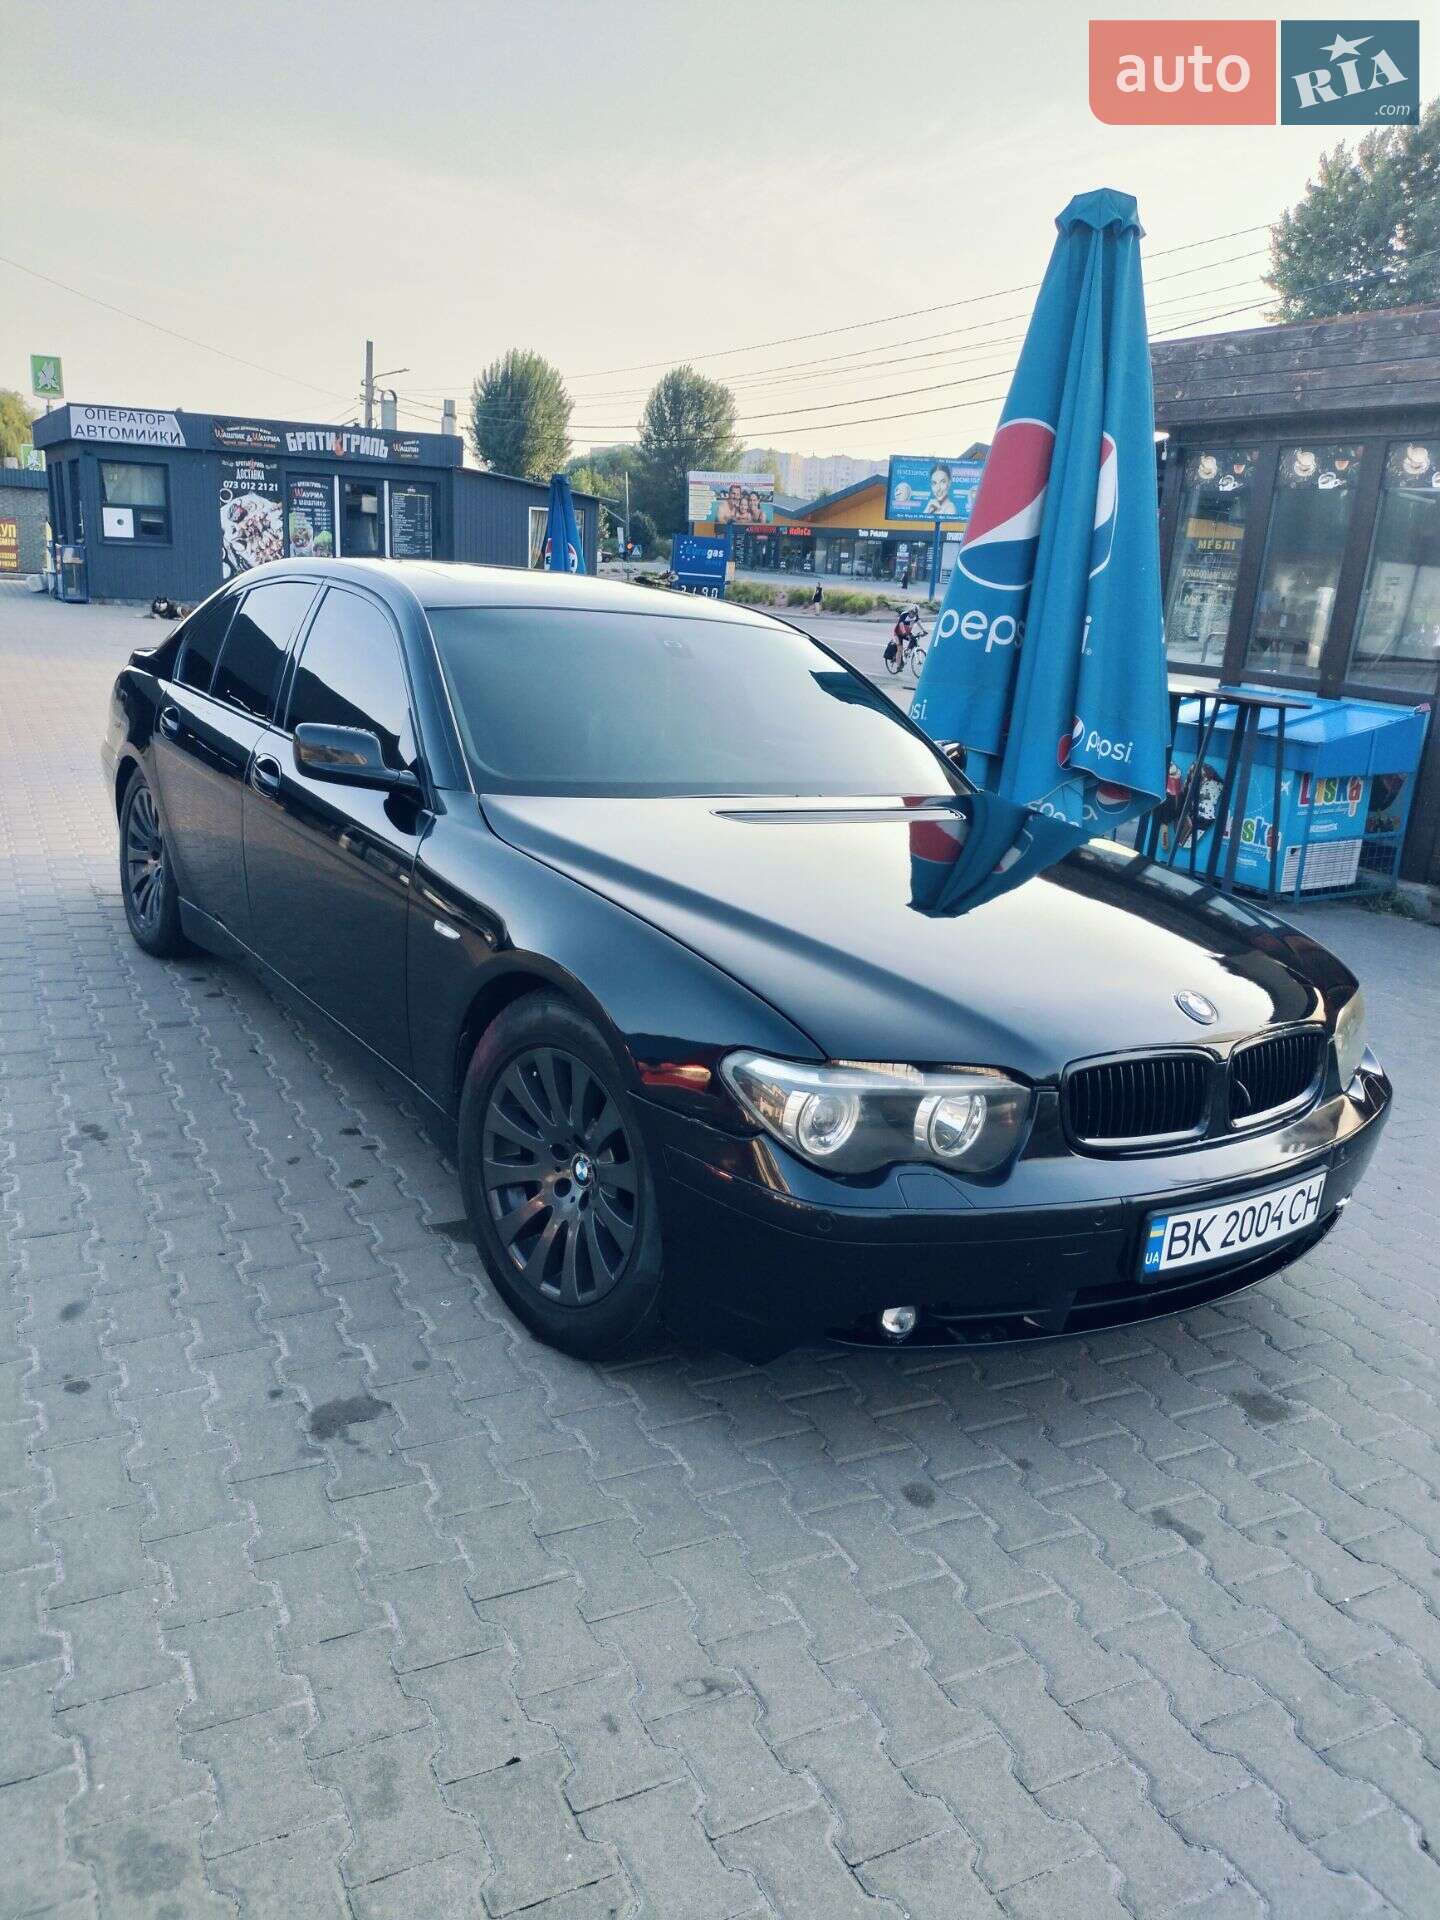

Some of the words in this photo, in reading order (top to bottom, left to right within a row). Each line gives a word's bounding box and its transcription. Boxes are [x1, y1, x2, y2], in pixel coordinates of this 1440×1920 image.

[84, 408, 166, 426] ОПЕРАТОР
[74, 424, 181, 445] АВТОМИЙКИ
[285, 431, 336, 452] БРАТИ
[342, 433, 389, 459] ГРИЛЬ
[223, 480, 239, 489] 073
[240, 481, 256, 491] 012
[706, 549, 725, 560] gas
[1166, 1214, 1218, 1262] BK
[1220, 1194, 1287, 1250] 2004
[1288, 1180, 1324, 1226] CH
[1145, 1252, 1160, 1265] UA
